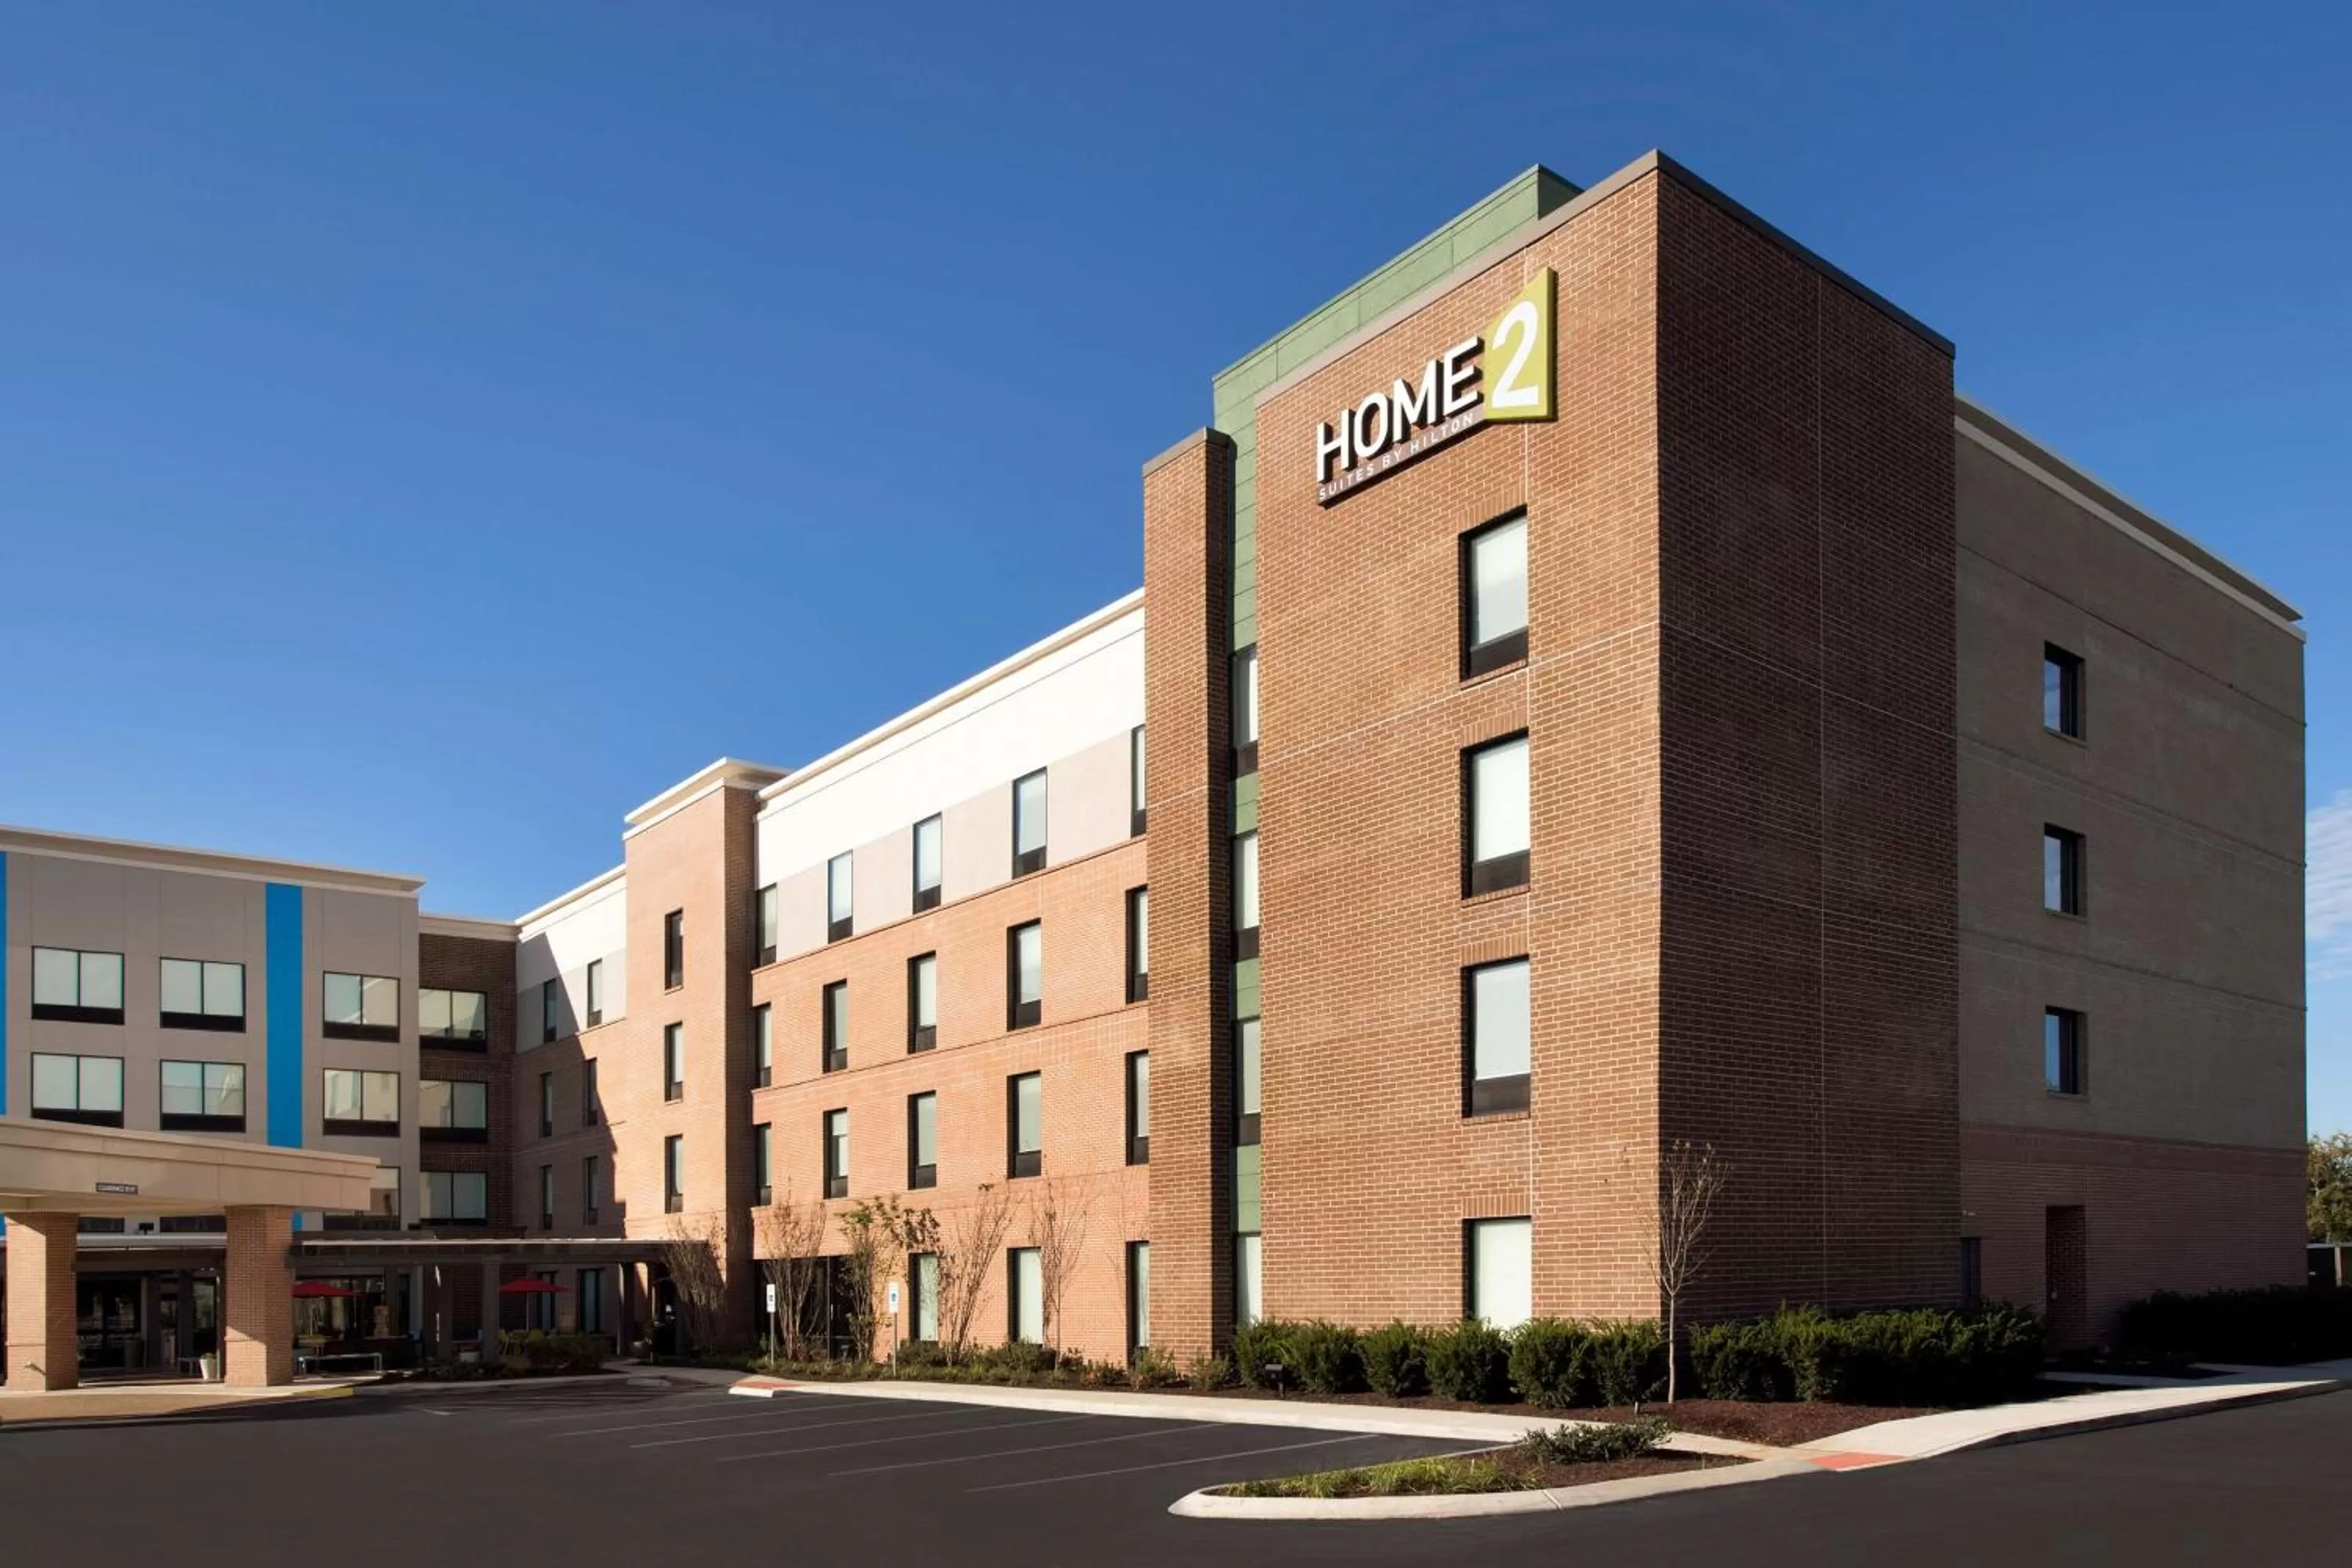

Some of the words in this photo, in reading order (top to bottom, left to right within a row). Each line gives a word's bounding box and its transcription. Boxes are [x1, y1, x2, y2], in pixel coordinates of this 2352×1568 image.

[1317, 336, 1478, 483] HOME
[1492, 301, 1539, 408] 2
[1319, 463, 1374, 500] SUITES
[1382, 449, 1403, 469] BY
[1411, 412, 1475, 452] HILTON
